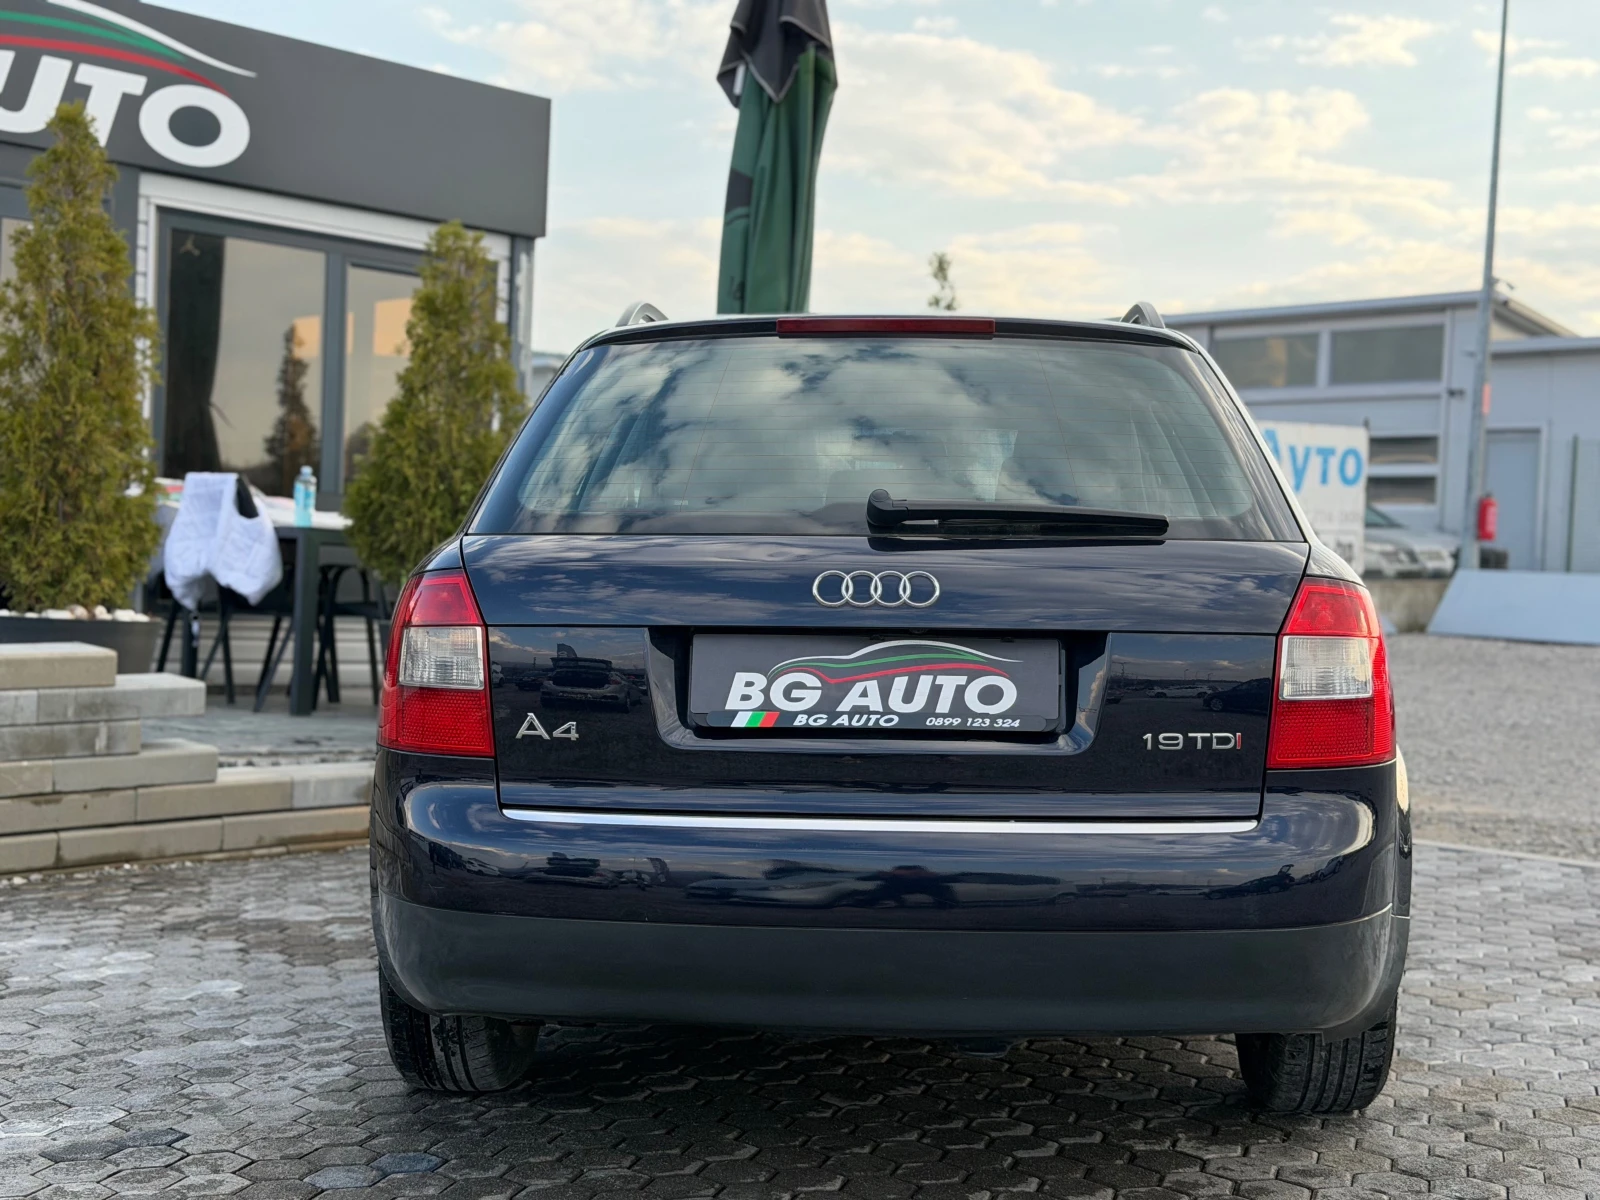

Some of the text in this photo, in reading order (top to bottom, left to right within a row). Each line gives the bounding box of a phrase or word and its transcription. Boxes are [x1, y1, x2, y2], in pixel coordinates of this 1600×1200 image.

[725, 672, 1018, 714] BG AUTO
[515, 712, 580, 741] A4
[793, 714, 1021, 728] BG AUTO 0899 123 324
